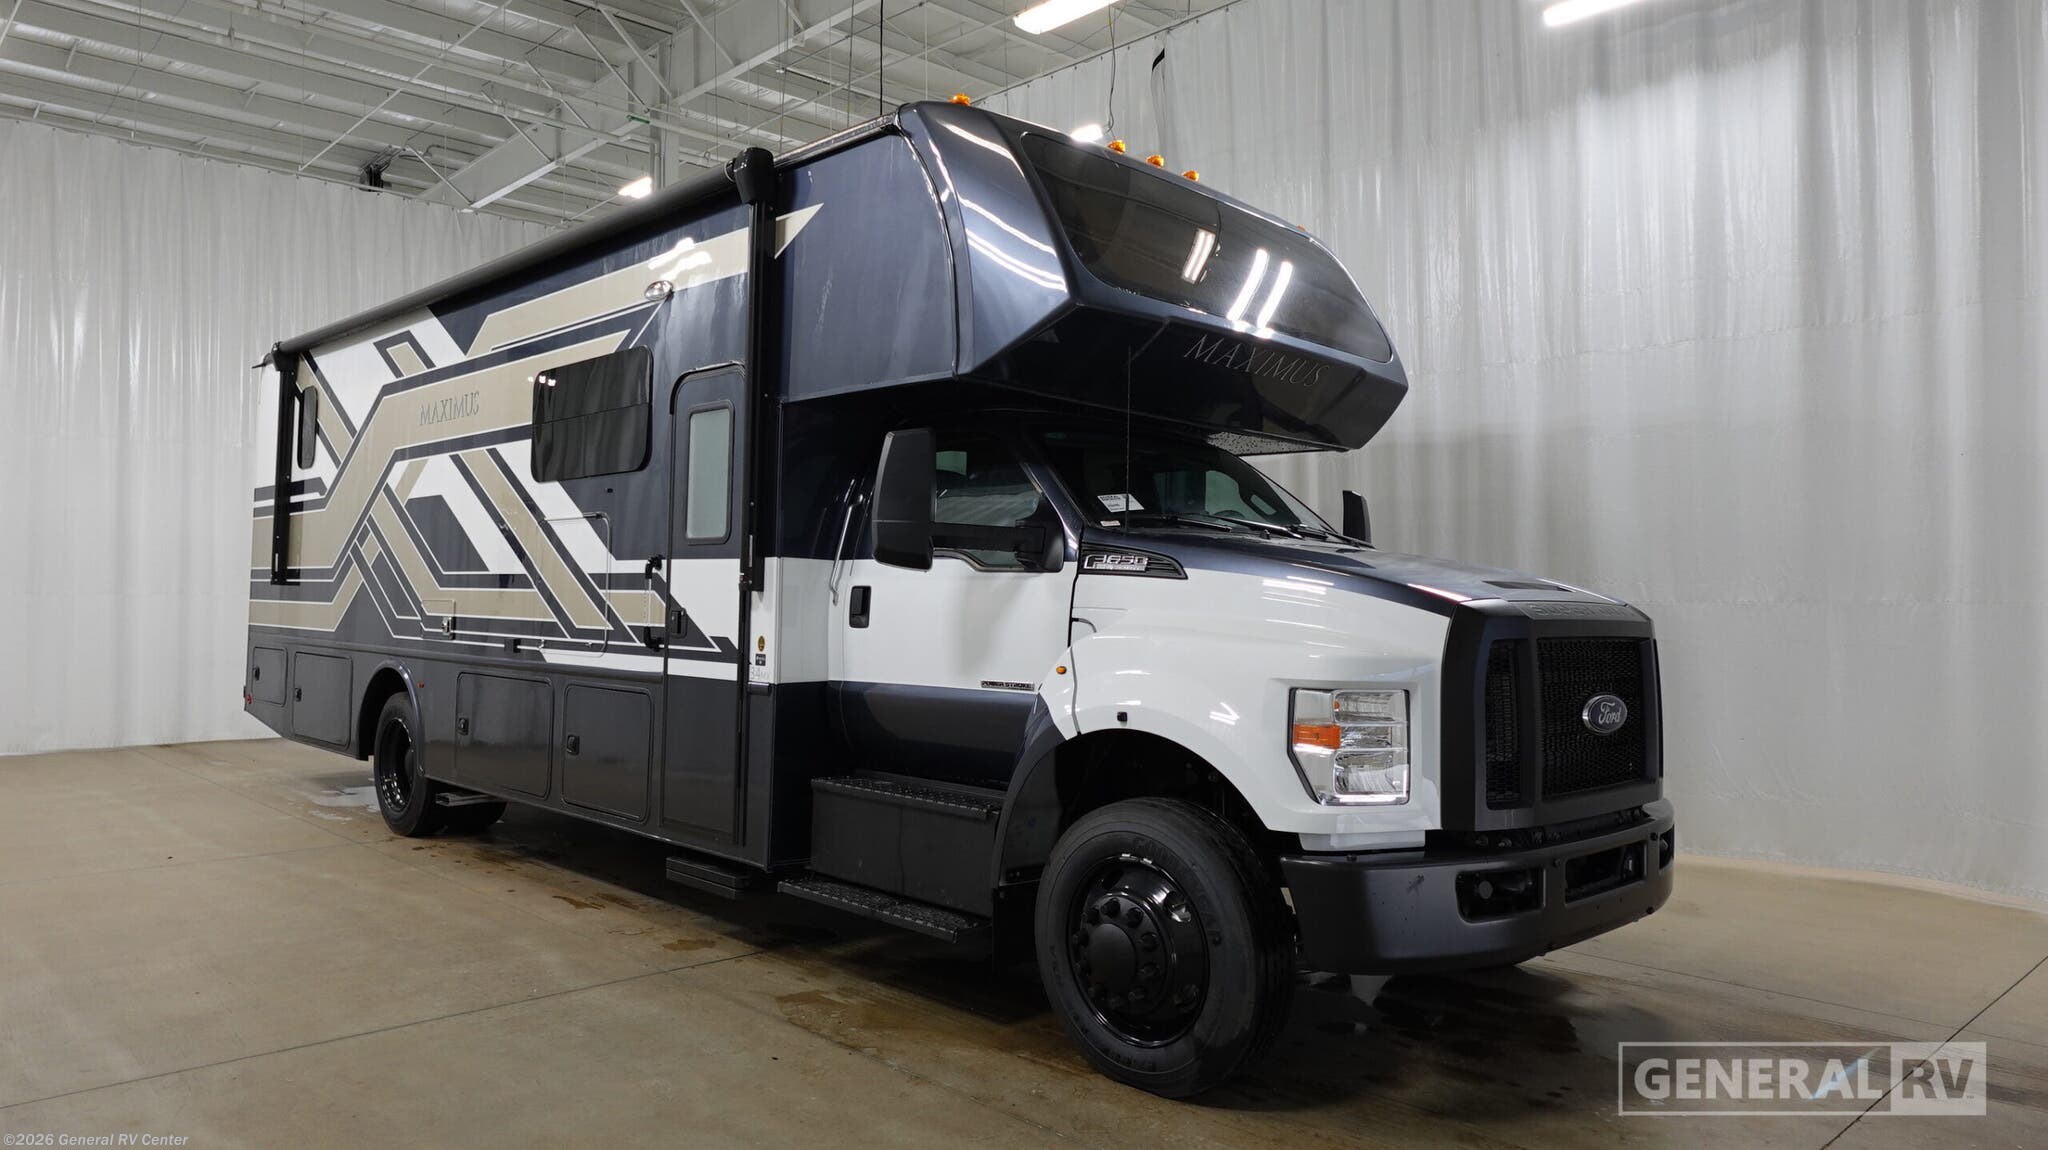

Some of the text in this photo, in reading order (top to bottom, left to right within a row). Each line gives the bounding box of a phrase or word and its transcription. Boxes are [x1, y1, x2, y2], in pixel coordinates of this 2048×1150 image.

[1183, 334, 1330, 387] MAXIMUS
[419, 390, 480, 426] MAXIMUS
[1598, 701, 1622, 725] Ford
